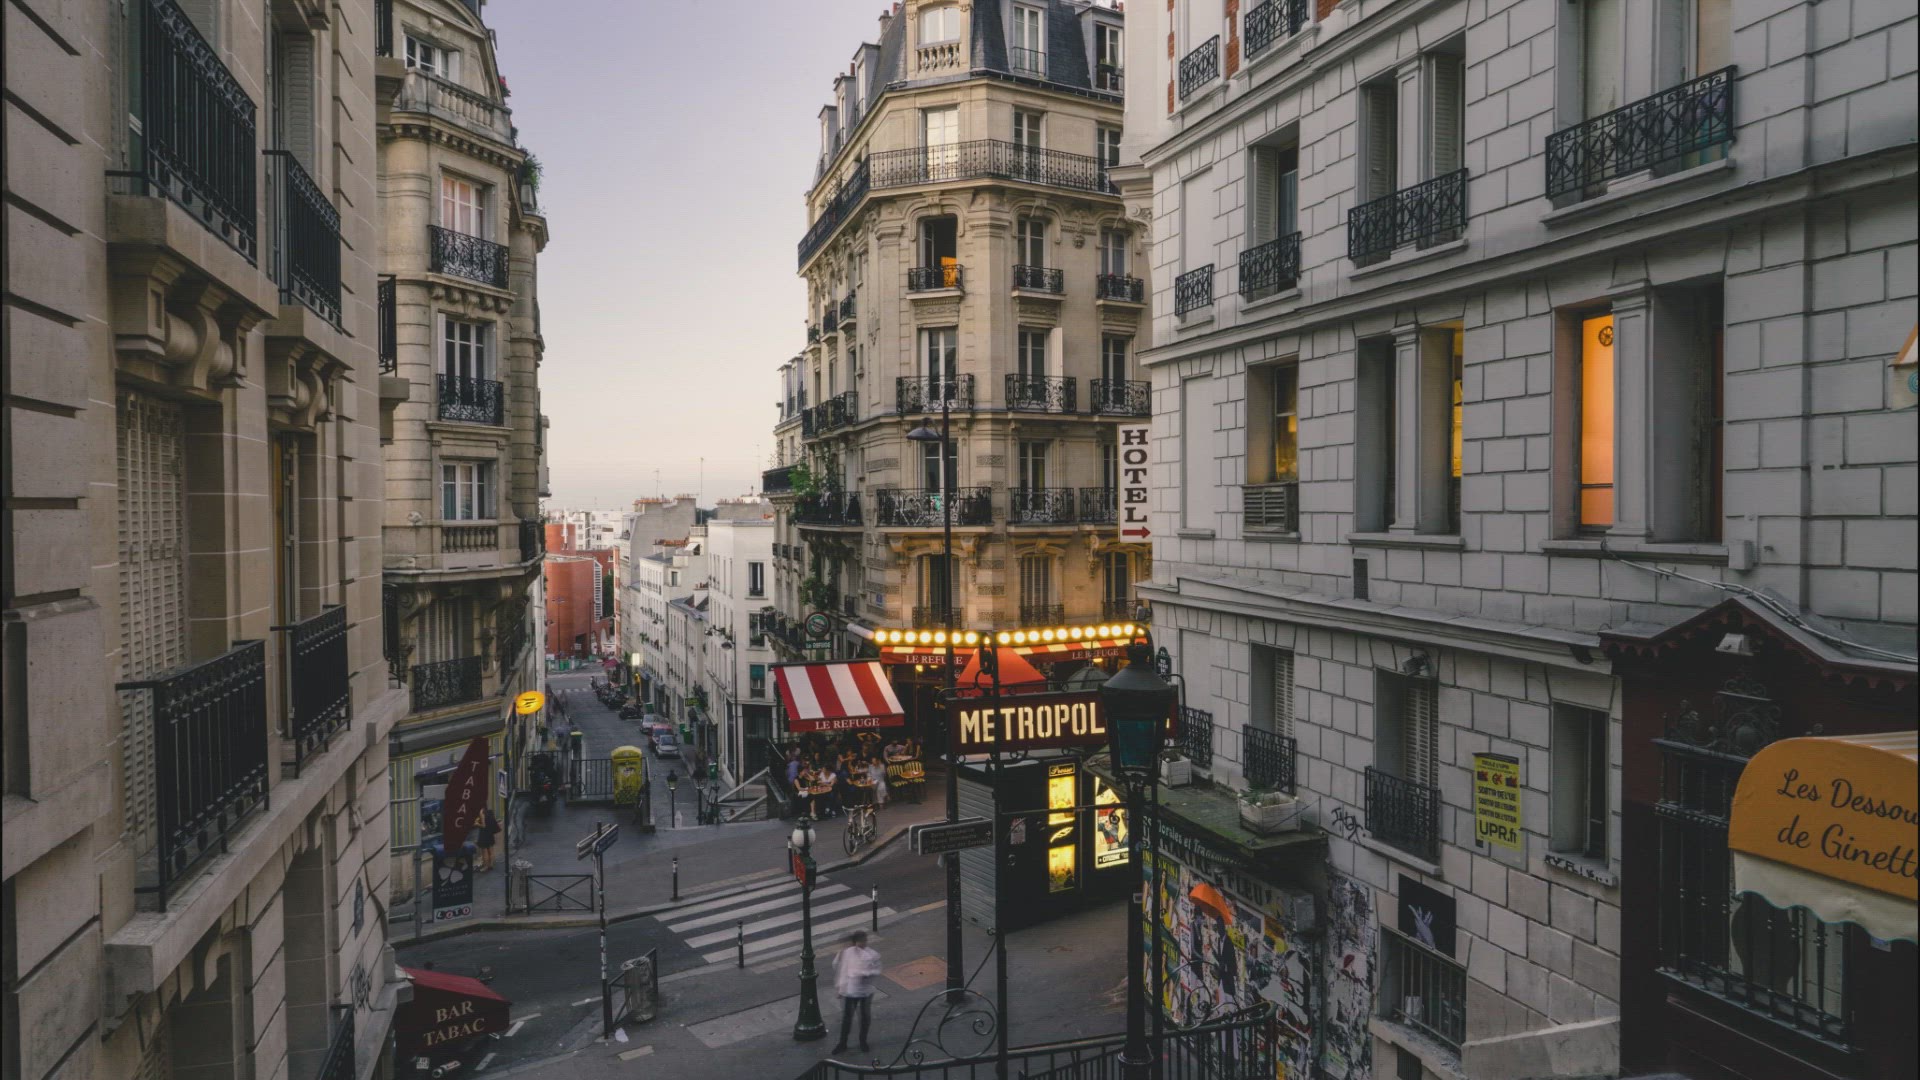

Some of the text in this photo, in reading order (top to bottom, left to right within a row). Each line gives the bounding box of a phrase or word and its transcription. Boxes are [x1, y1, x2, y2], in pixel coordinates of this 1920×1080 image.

[1122, 429, 1148, 523] HOTEL
[905, 655, 920, 664] LE
[815, 717, 880, 730] LE REFUGE
[960, 702, 1105, 744] METROPOL
[454, 760, 481, 829] TABAC
[1777, 768, 1821, 802] Les
[1479, 819, 1518, 844] UPR.fr
[1777, 814, 1918, 880] de Ginett
[436, 906, 471, 921] LOTO
[435, 1000, 474, 1024] BAR
[423, 1018, 486, 1047] TABAC
